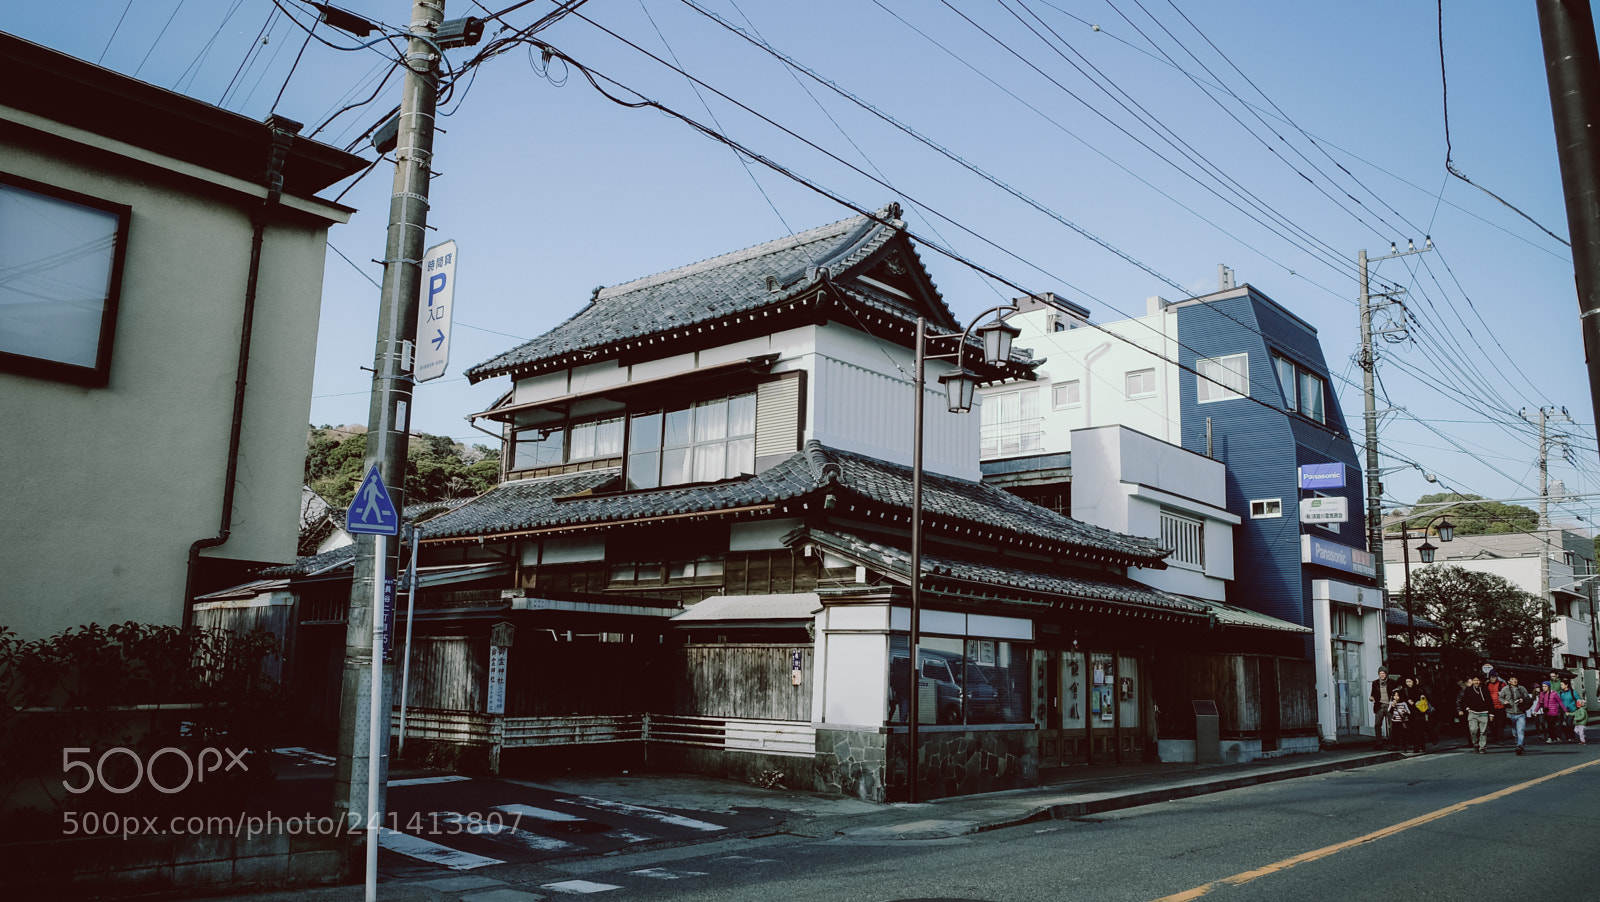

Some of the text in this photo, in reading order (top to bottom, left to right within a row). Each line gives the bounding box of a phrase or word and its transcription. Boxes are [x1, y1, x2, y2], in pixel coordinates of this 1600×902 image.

[427, 253, 452, 271] 時間貸
[428, 272, 447, 307] P
[427, 305, 445, 324] 入口
[1303, 472, 1341, 480] Panasonic
[1315, 543, 1347, 566] Panasonic
